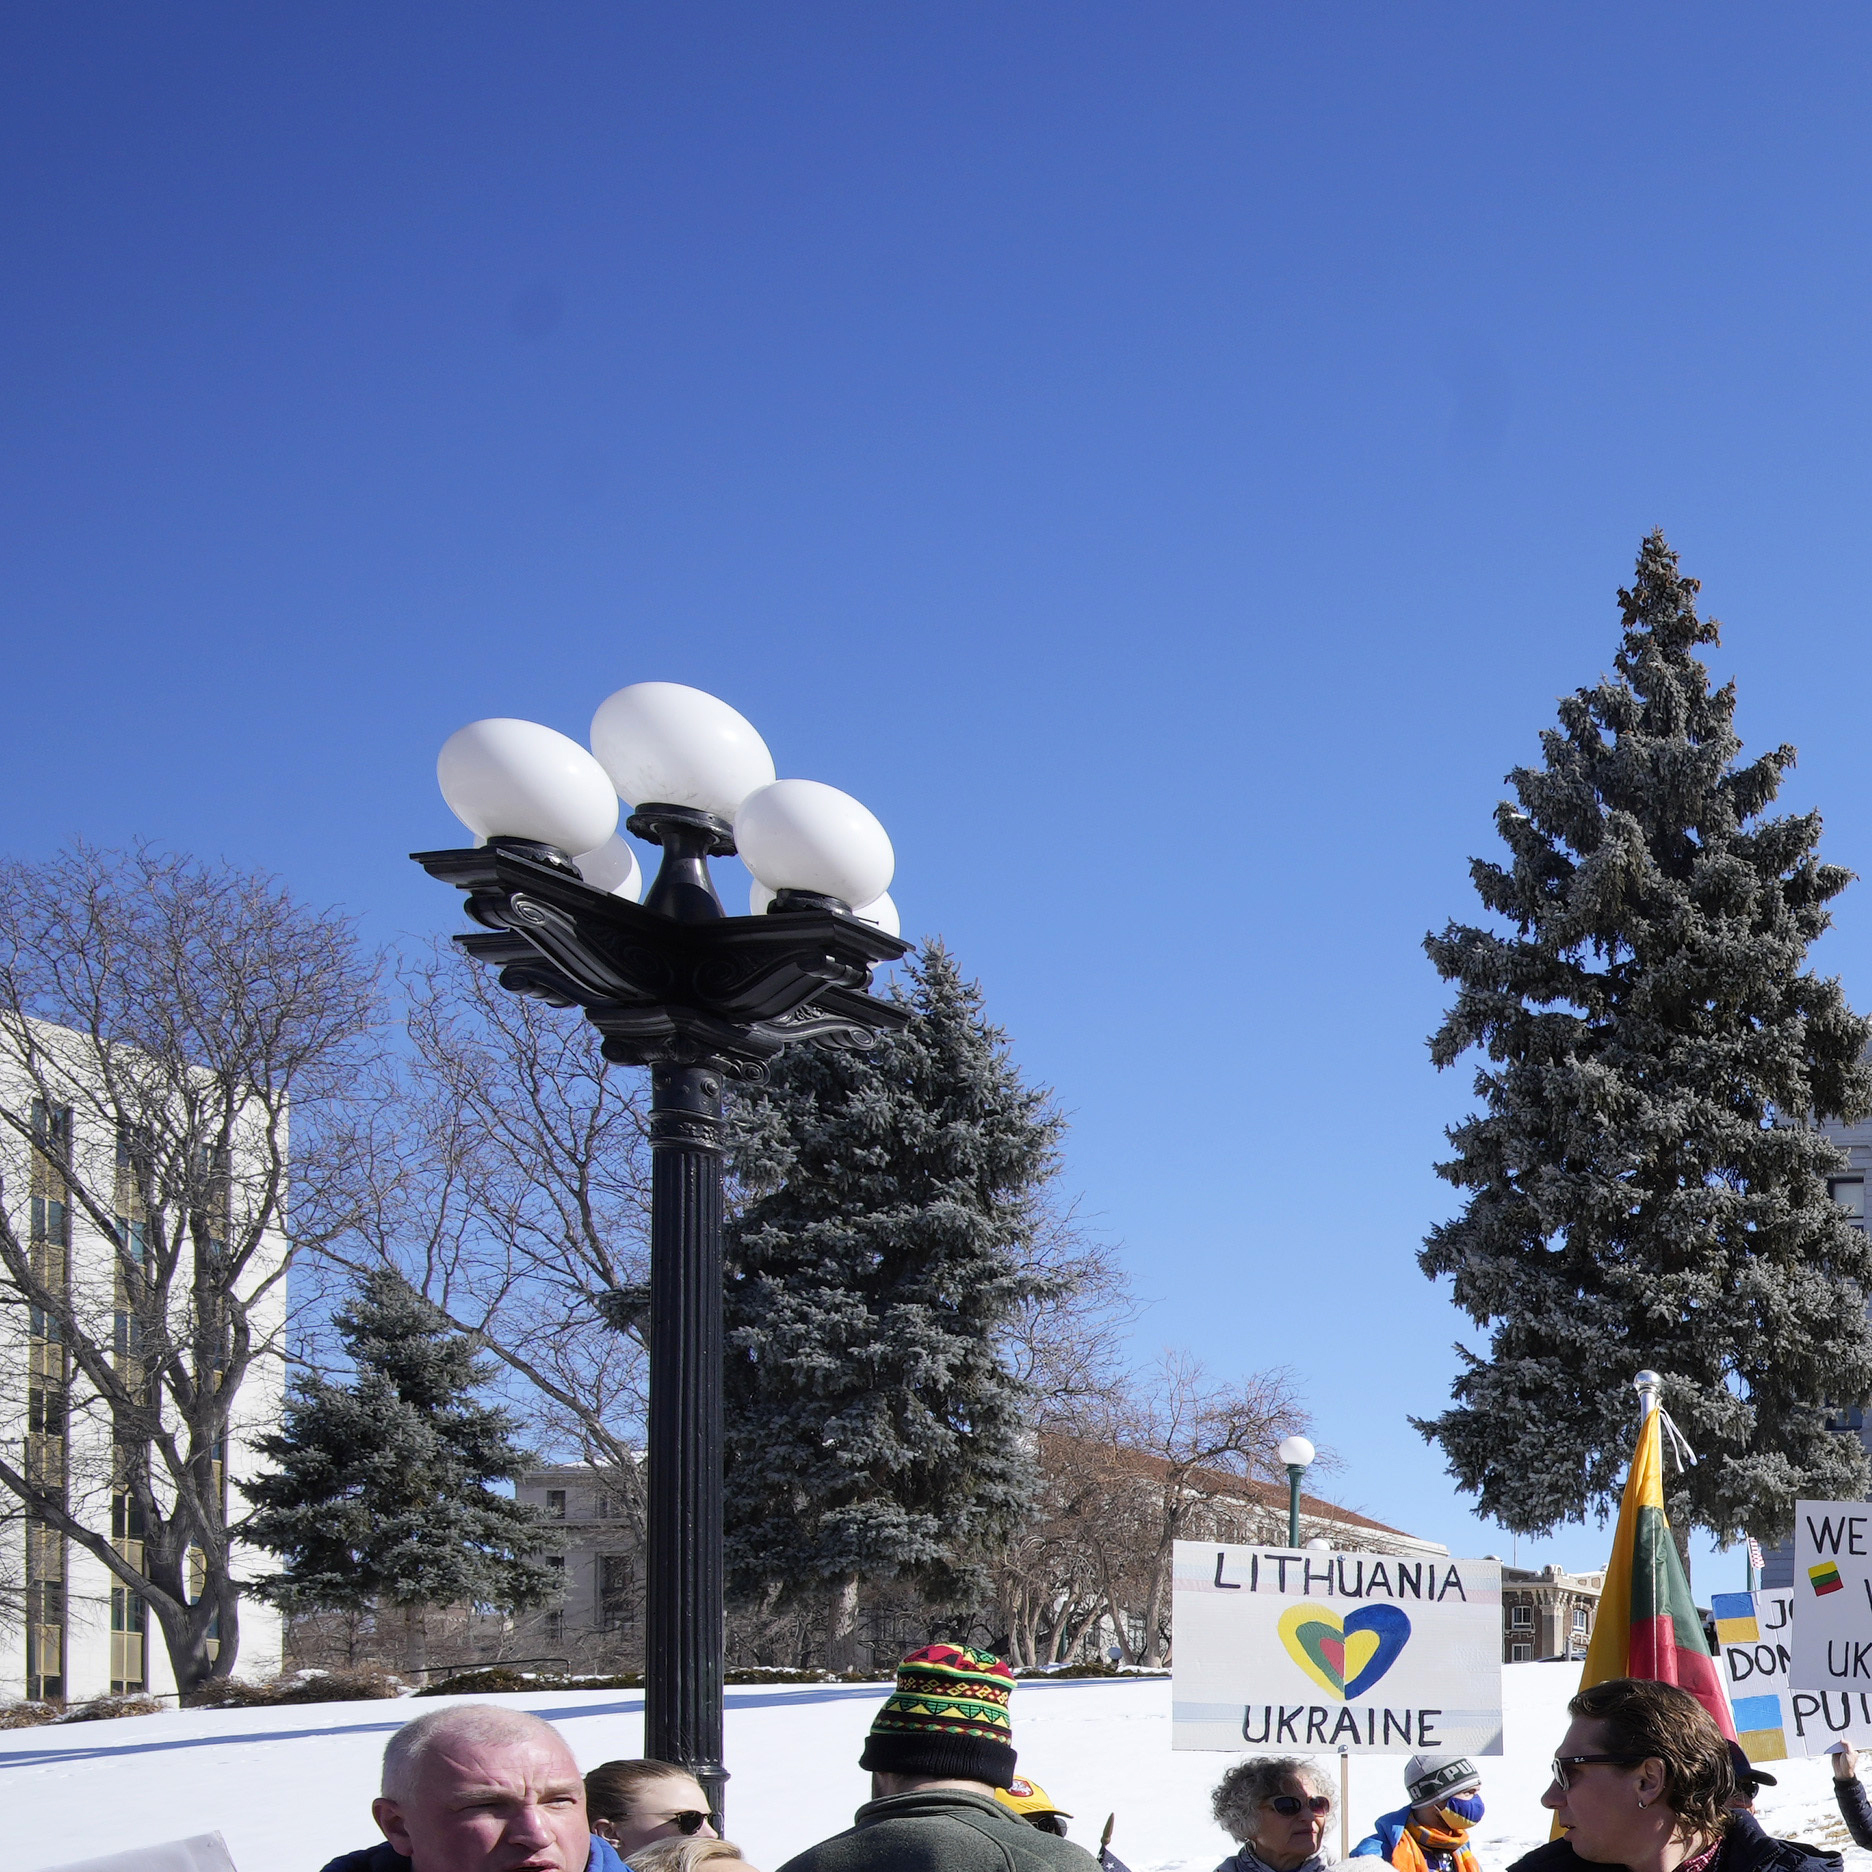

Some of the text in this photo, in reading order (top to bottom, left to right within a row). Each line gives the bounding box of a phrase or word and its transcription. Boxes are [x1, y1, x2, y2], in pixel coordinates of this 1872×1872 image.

[1806, 1515, 1868, 1556] WE
[1214, 1552, 1467, 1602] LITHUANIA
[1242, 1705, 1443, 1747] UKRAINE
[1442, 1759, 1478, 1782] PU
